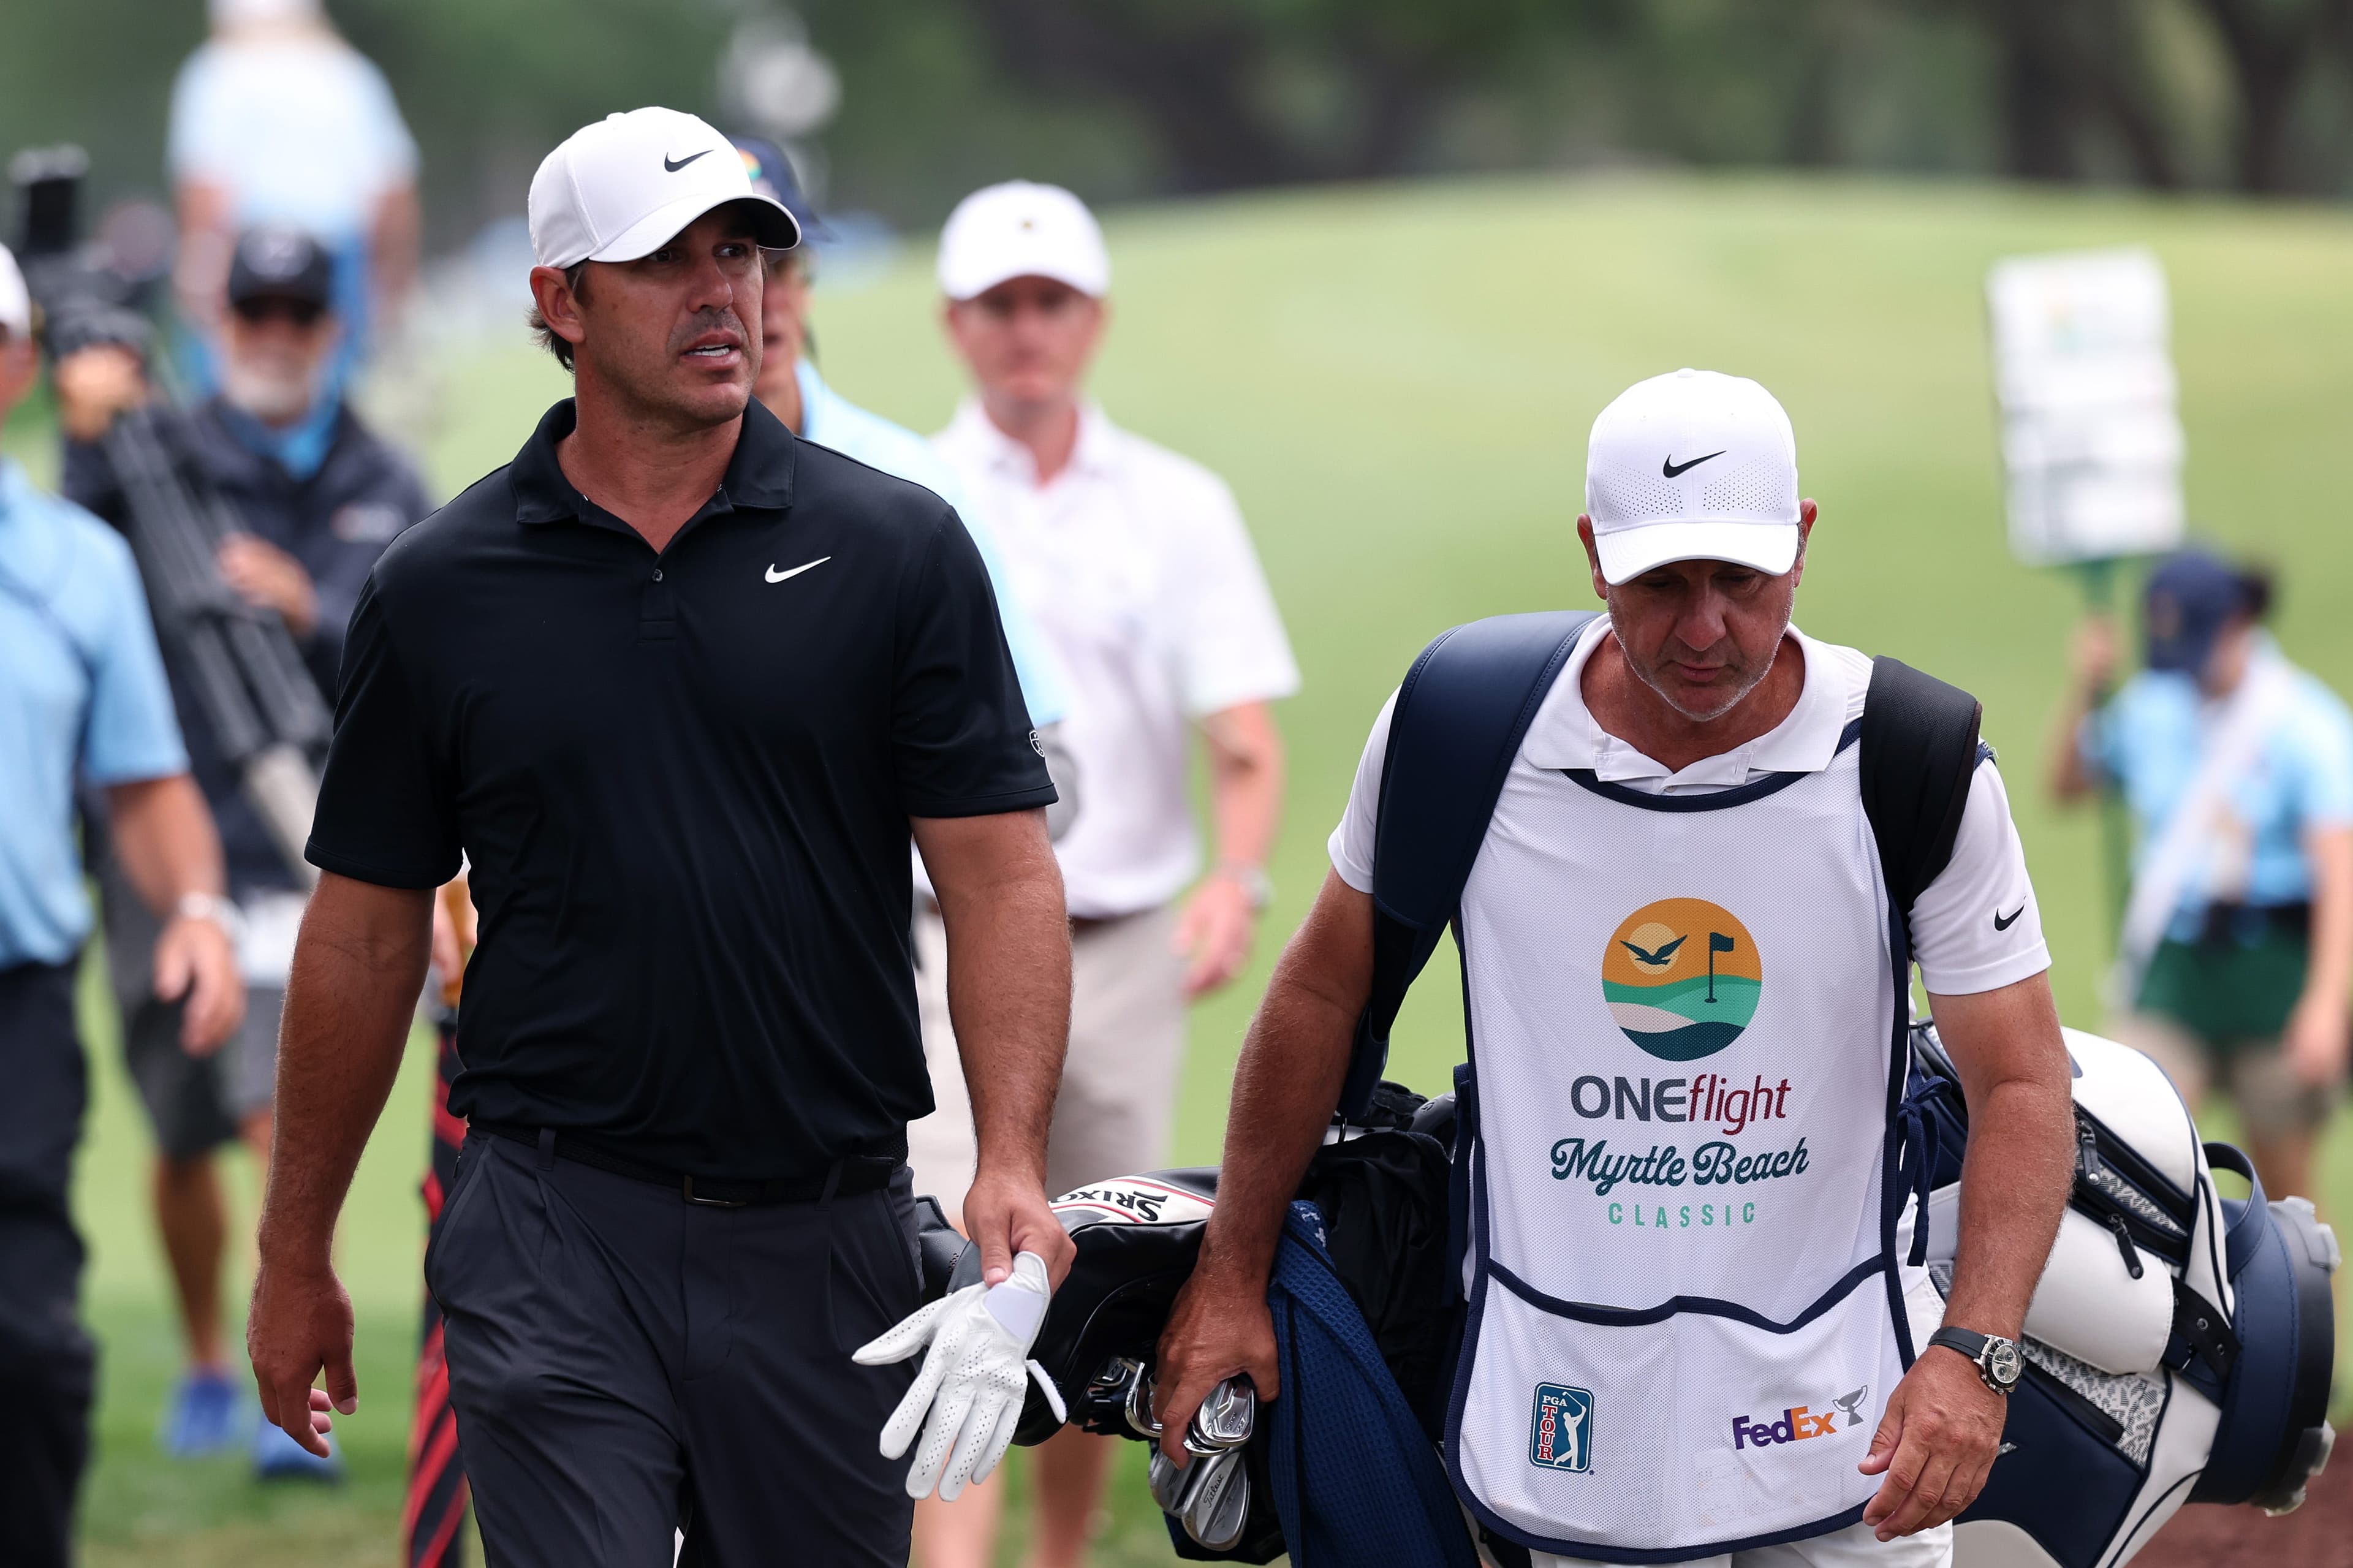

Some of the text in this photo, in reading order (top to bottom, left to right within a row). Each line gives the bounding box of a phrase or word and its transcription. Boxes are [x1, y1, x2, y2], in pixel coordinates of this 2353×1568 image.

[1571, 1074, 1792, 1135] ONEflight
[1550, 1137, 1809, 1197] Myrtle Beach
[1608, 1202, 1756, 1229] CLASSIC
[1542, 1395, 1568, 1407] PGA
[1537, 1404, 1558, 1461] TOUR
[1732, 1406, 1837, 1450] FedEx
